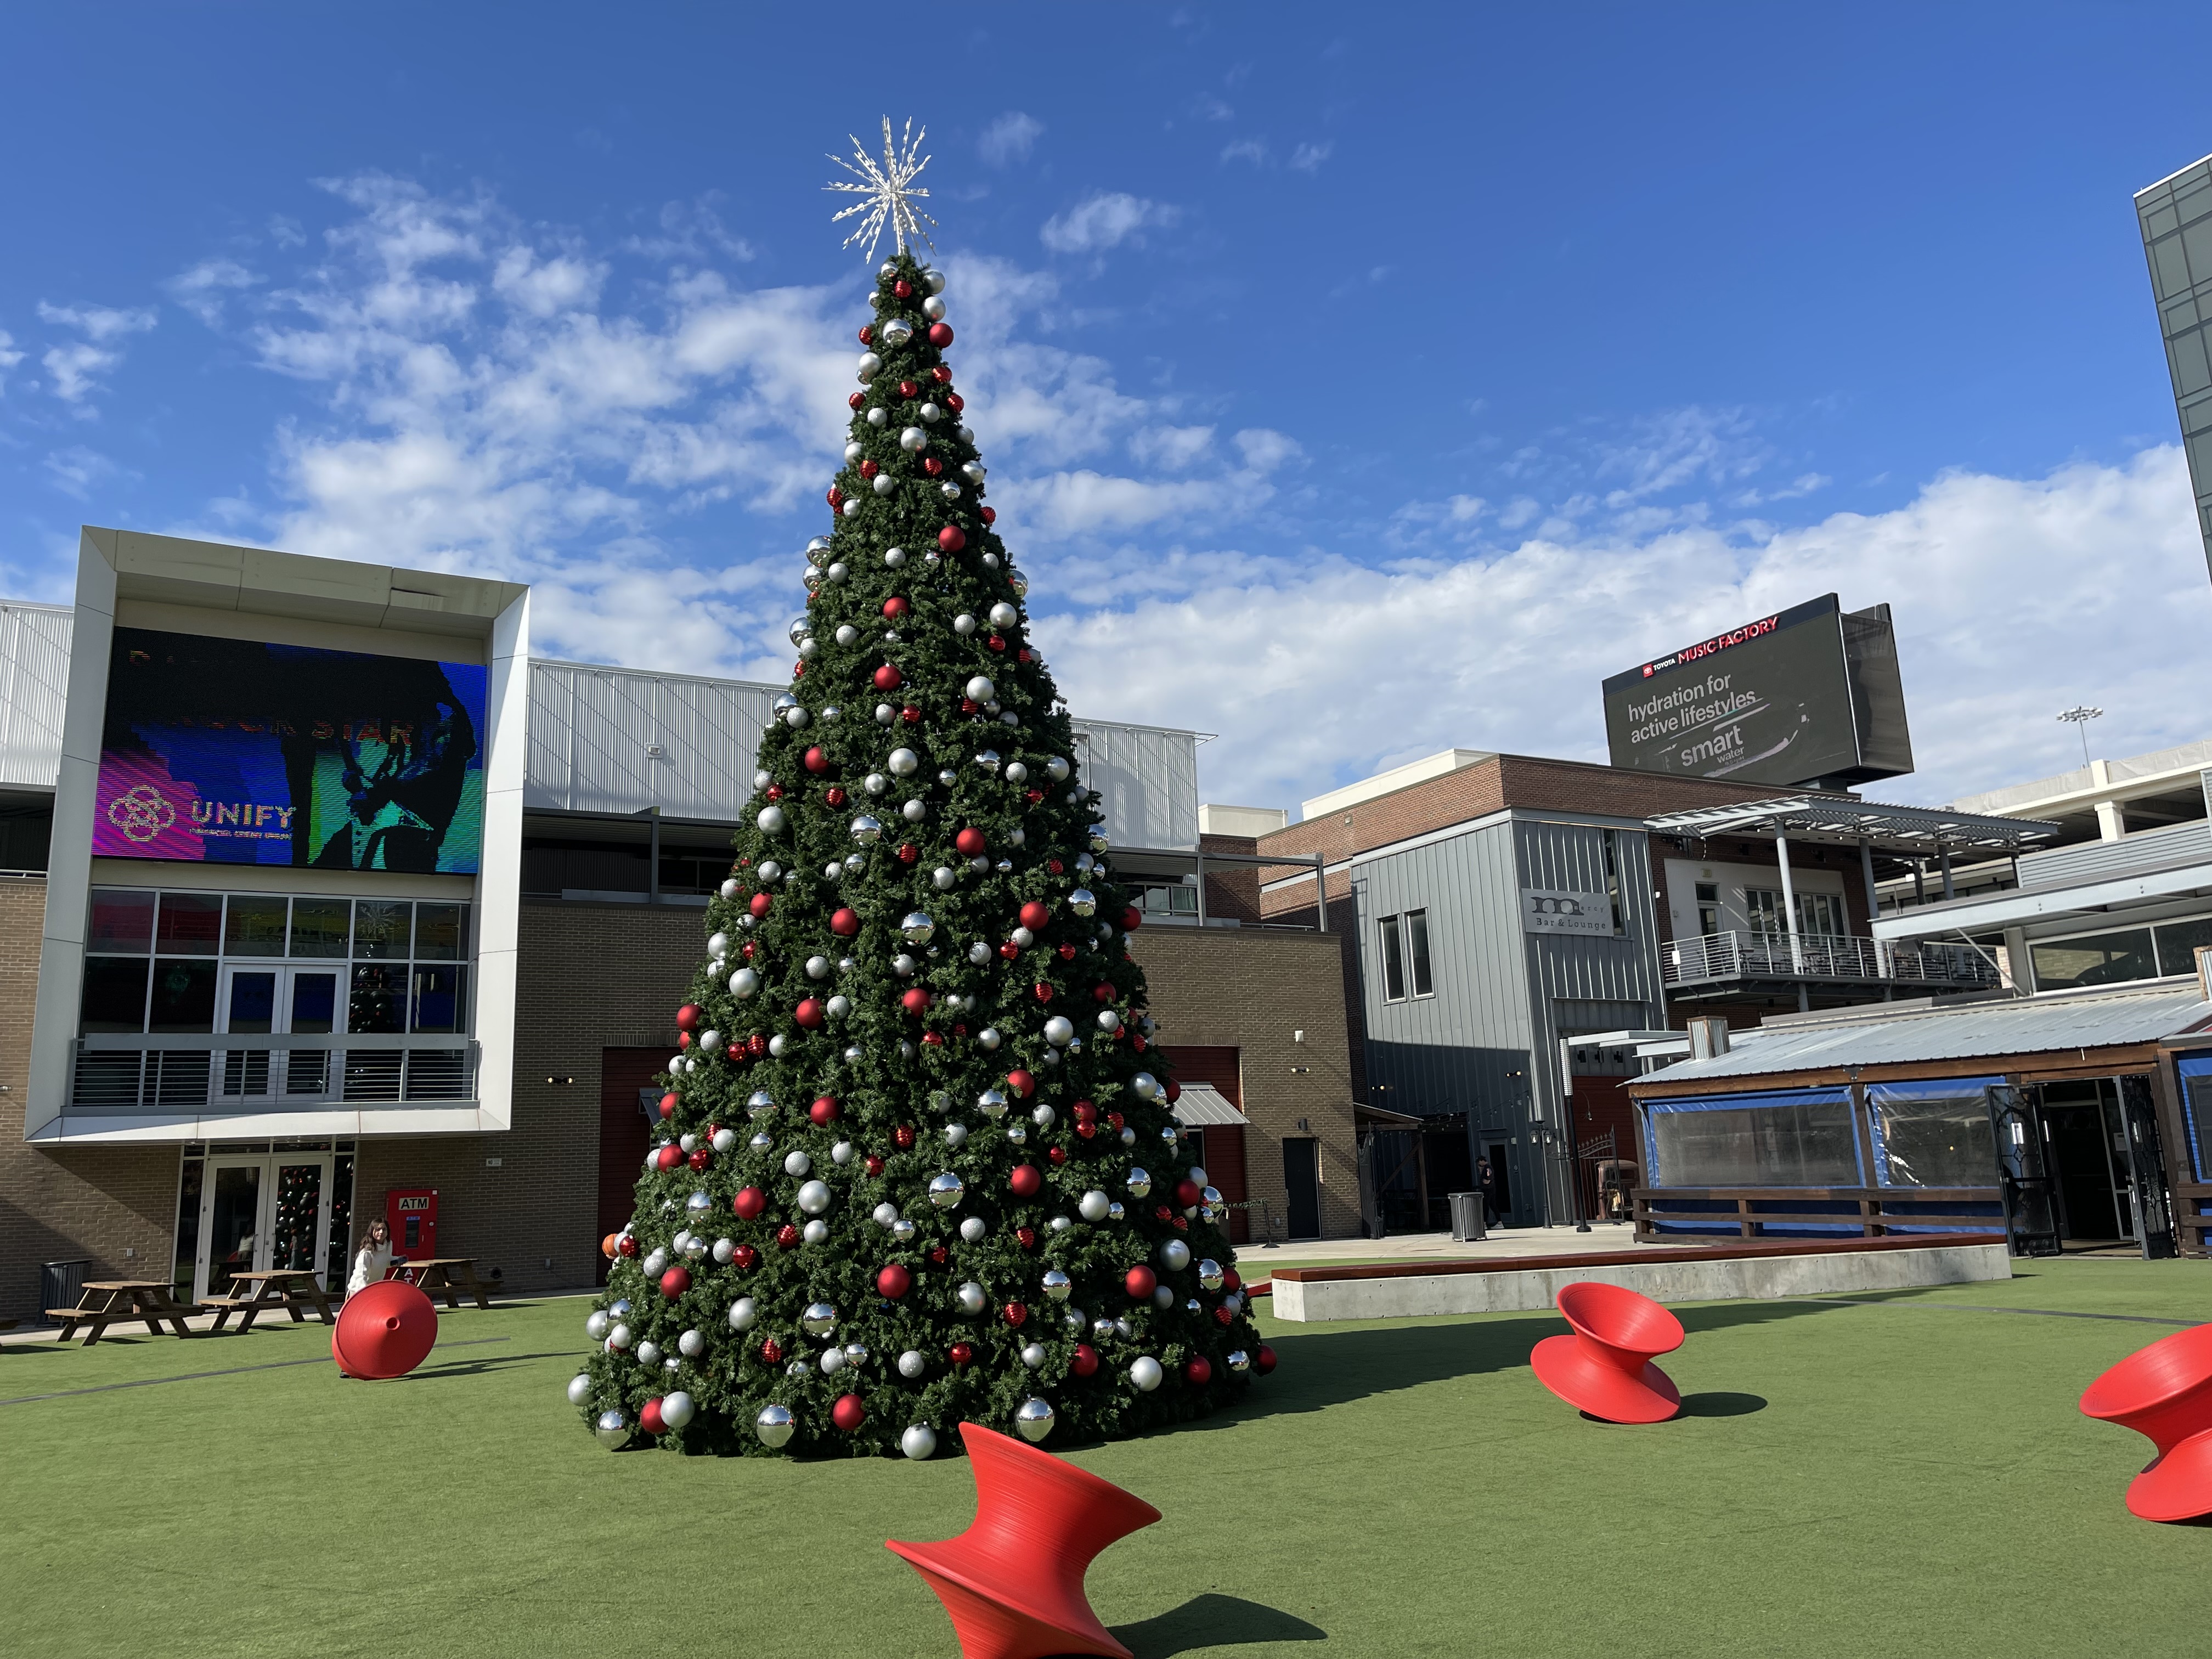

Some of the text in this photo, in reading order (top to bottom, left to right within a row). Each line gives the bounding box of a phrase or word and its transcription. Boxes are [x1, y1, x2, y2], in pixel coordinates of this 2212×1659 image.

[1654, 616, 1779, 671] TOYOTA MUSIC FACTORY
[1628, 674, 1731, 722] hydration for
[1631, 691, 1756, 743] active lifestyles
[1681, 725, 1743, 767] smart
[1717, 746, 1745, 763] water
[191, 801, 297, 829] UNIFY
[1536, 918, 1606, 930] Bar & Lounge
[400, 1198, 427, 1209] ATM
